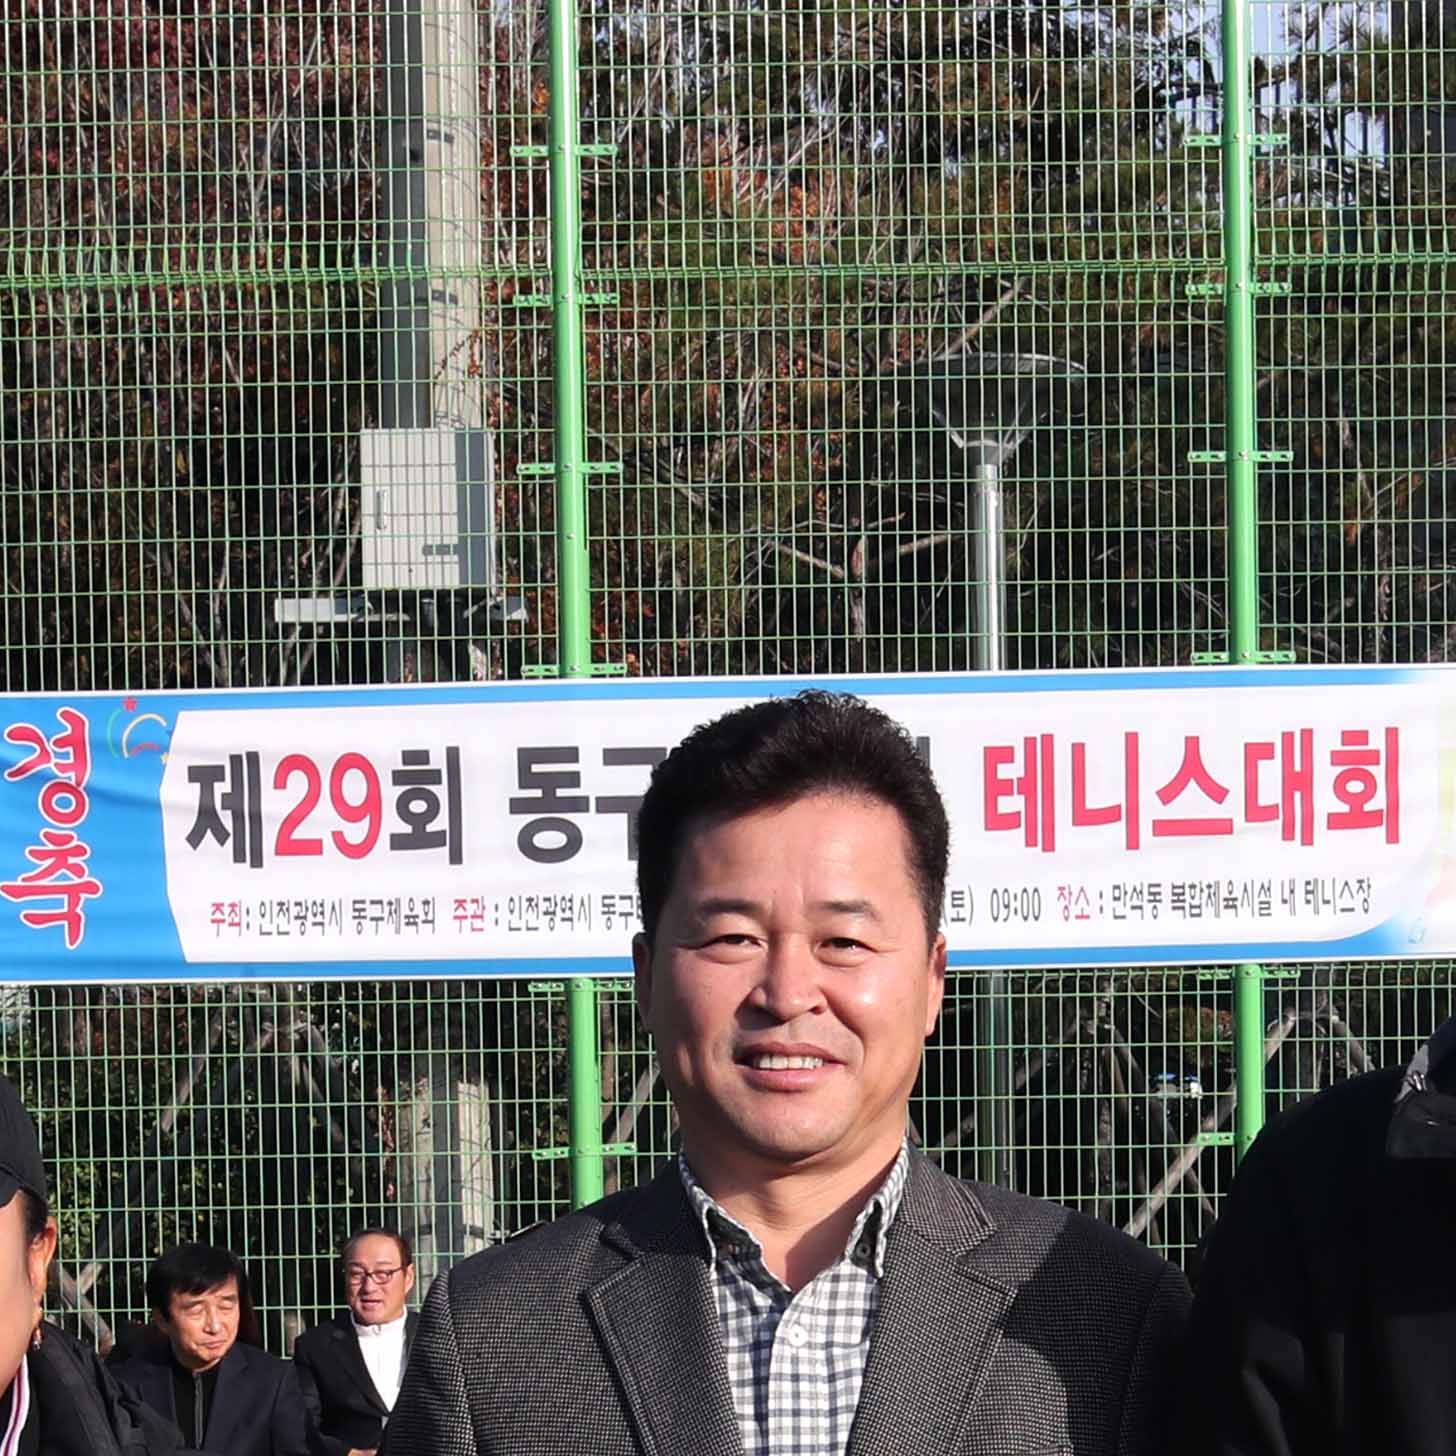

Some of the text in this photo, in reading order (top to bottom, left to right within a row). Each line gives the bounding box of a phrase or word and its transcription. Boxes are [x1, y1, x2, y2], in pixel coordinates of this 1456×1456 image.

[0, 708, 101, 949] 경축
[185, 745, 464, 869] 제29회
[983, 727, 1400, 852] 테니스대회
[259, 898, 343, 936] 인천광역시
[352, 896, 436, 935] 동구체육회
[453, 895, 486, 934] 주관
[508, 893, 592, 932] 인천광역시
[990, 886, 1042, 923] 09:00
[1057, 883, 1091, 922] 장소
[1112, 882, 1163, 921] 만석동
[1171, 878, 1272, 919] 복합체육시설
[1281, 877, 1296, 916] 내
[1305, 877, 1372, 917] 테니스장
